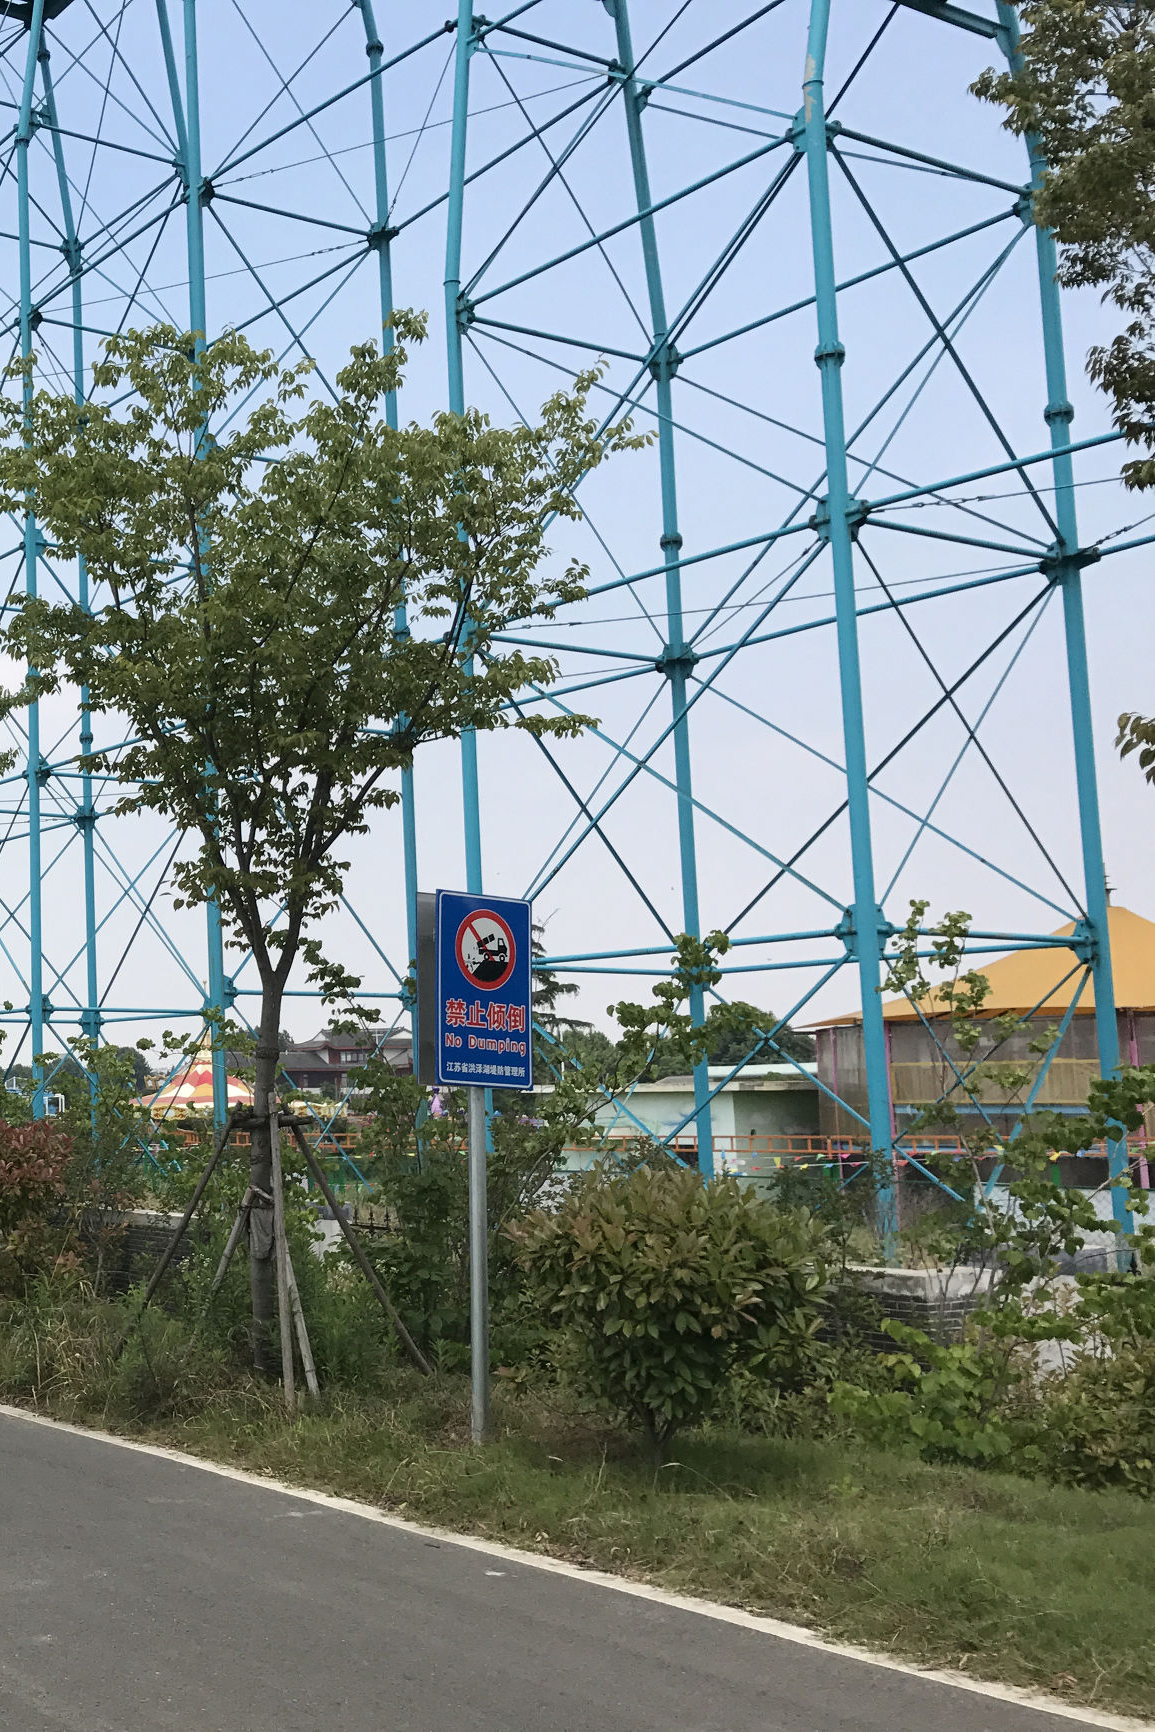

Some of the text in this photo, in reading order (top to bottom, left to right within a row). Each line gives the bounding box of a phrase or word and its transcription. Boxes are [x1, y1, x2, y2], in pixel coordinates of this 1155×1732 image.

[445, 998, 526, 1033] 禁止倾倒
[445, 1033, 526, 1057] No Dumping
[446, 1061, 525, 1077] 江苏省洪泽湖堤防管理所
